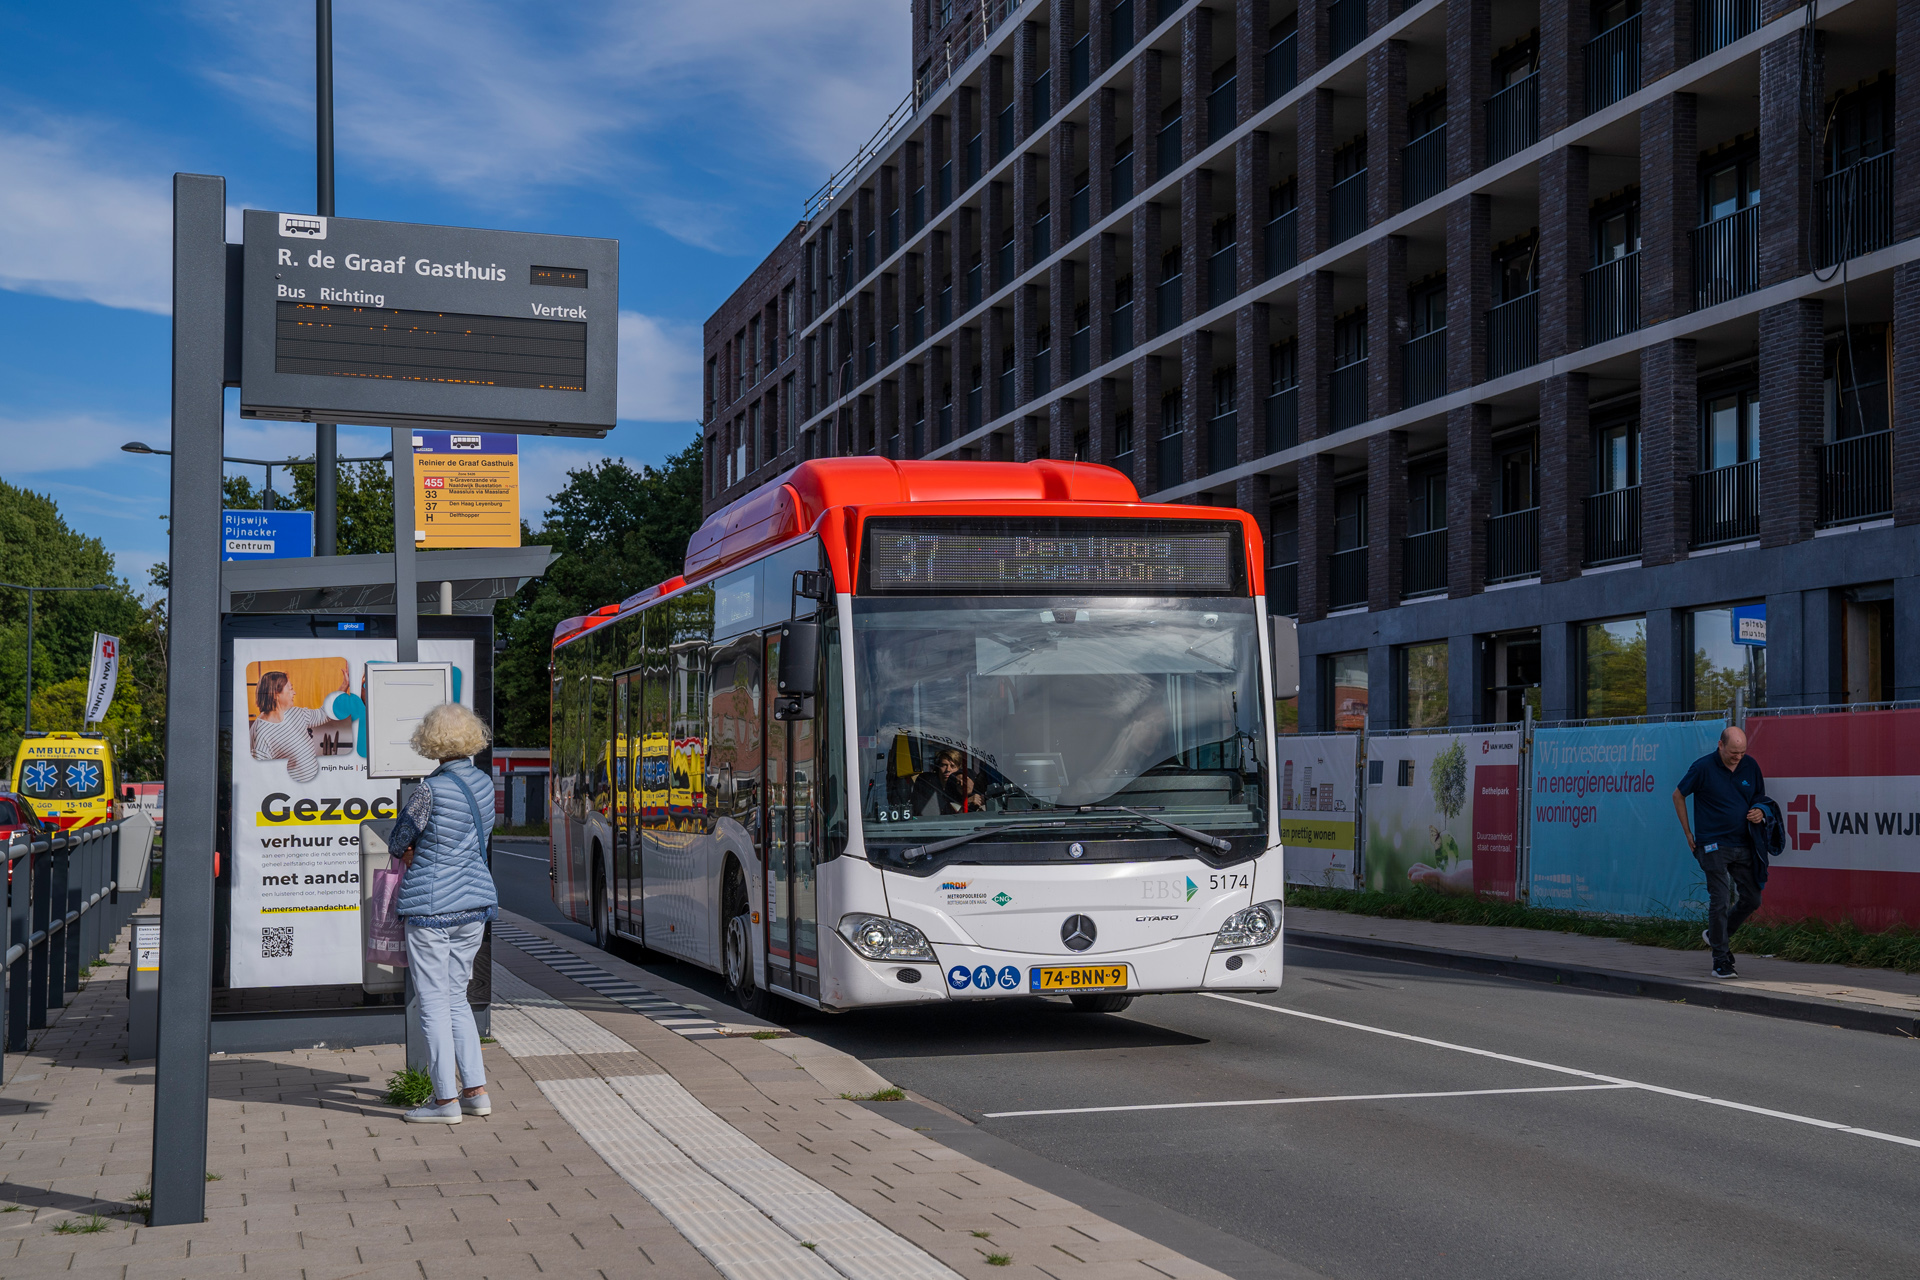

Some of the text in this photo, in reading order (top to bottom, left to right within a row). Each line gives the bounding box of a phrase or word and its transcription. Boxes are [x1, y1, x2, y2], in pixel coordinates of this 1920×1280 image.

[278, 248, 506, 282] R. de Graaf Gasthuis
[277, 284, 385, 308] Bus Richting
[531, 302, 587, 319] Vertrek
[424, 478, 443, 487] 455
[425, 490, 437, 498] 33
[425, 502, 437, 510] 37
[226, 515, 268, 527] Rijswijk
[426, 514, 434, 522] H
[226, 527, 277, 538] Pijnacker
[228, 542, 272, 550] Centrum
[897, 536, 939, 581] 37
[1015, 536, 1078, 558] Den
[88, 661, 111, 718] VAN WIJNEN
[1538, 737, 1659, 770] Wij investeren hier
[1482, 787, 1509, 795] Bethelpark
[1537, 770, 1655, 798] in energieneutrale
[880, 810, 910, 820] 205
[1536, 801, 1597, 828] woningen
[1827, 812, 1868, 834] VAN
[261, 834, 333, 848] verhuur
[1291, 827, 1312, 843] prettig
[1313, 831, 1336, 840] wonen
[1477, 832, 1513, 841] Duurzaamheid
[262, 870, 359, 886] met aanda
[1210, 875, 1248, 889] 5174
[942, 882, 966, 890] MRDH
[1142, 880, 1182, 899] EBS
[262, 903, 357, 913] kamersmetaandacht.nl
[1044, 969, 1121, 986] 74-BNN-9
